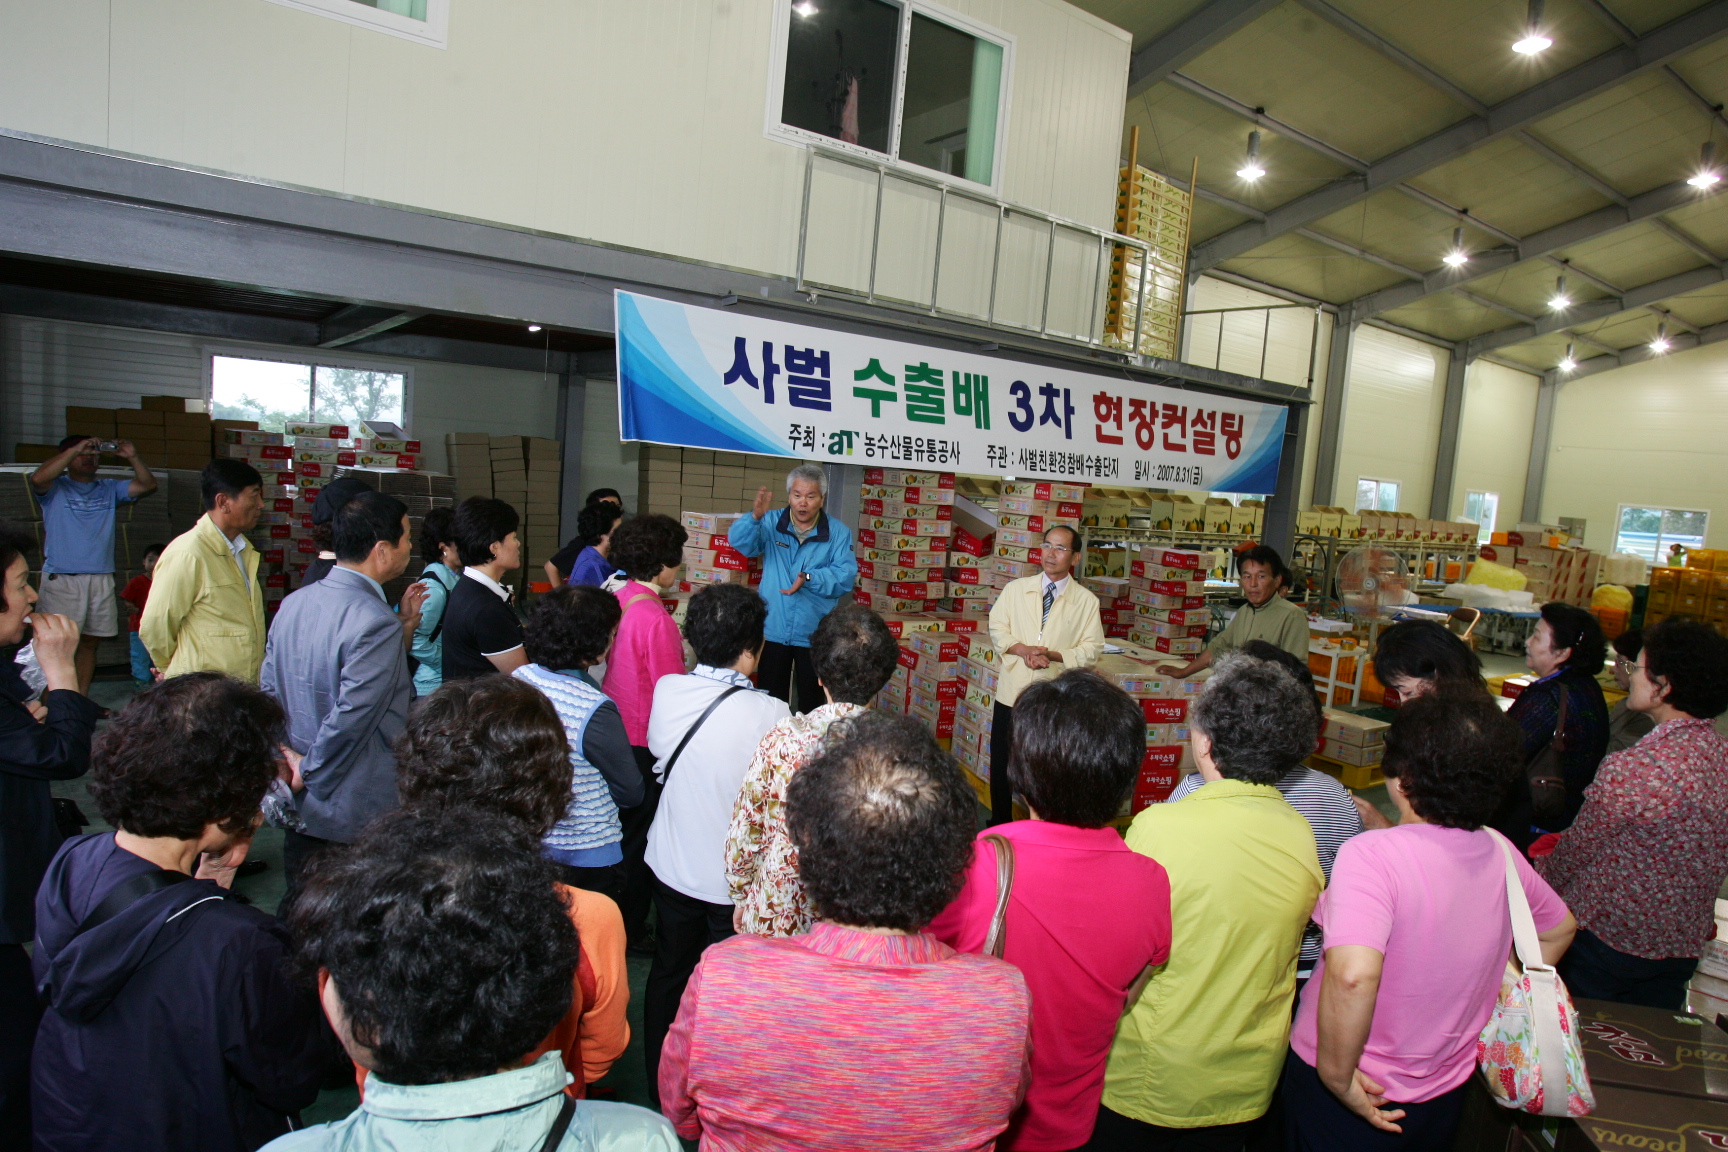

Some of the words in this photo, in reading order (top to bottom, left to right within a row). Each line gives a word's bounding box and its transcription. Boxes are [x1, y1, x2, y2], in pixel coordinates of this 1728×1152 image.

[723, 336, 832, 412] 사벌
[852, 357, 991, 430] 수출배
[1007, 380, 1076, 440] 3차
[1092, 391, 1244, 460] 현장컨설팅
[864, 431, 961, 465] 농수산물유통공사
[1018, 448, 1119, 479] 사벌친환경참배수출단지
[1676, 1046, 1728, 1062] pea
